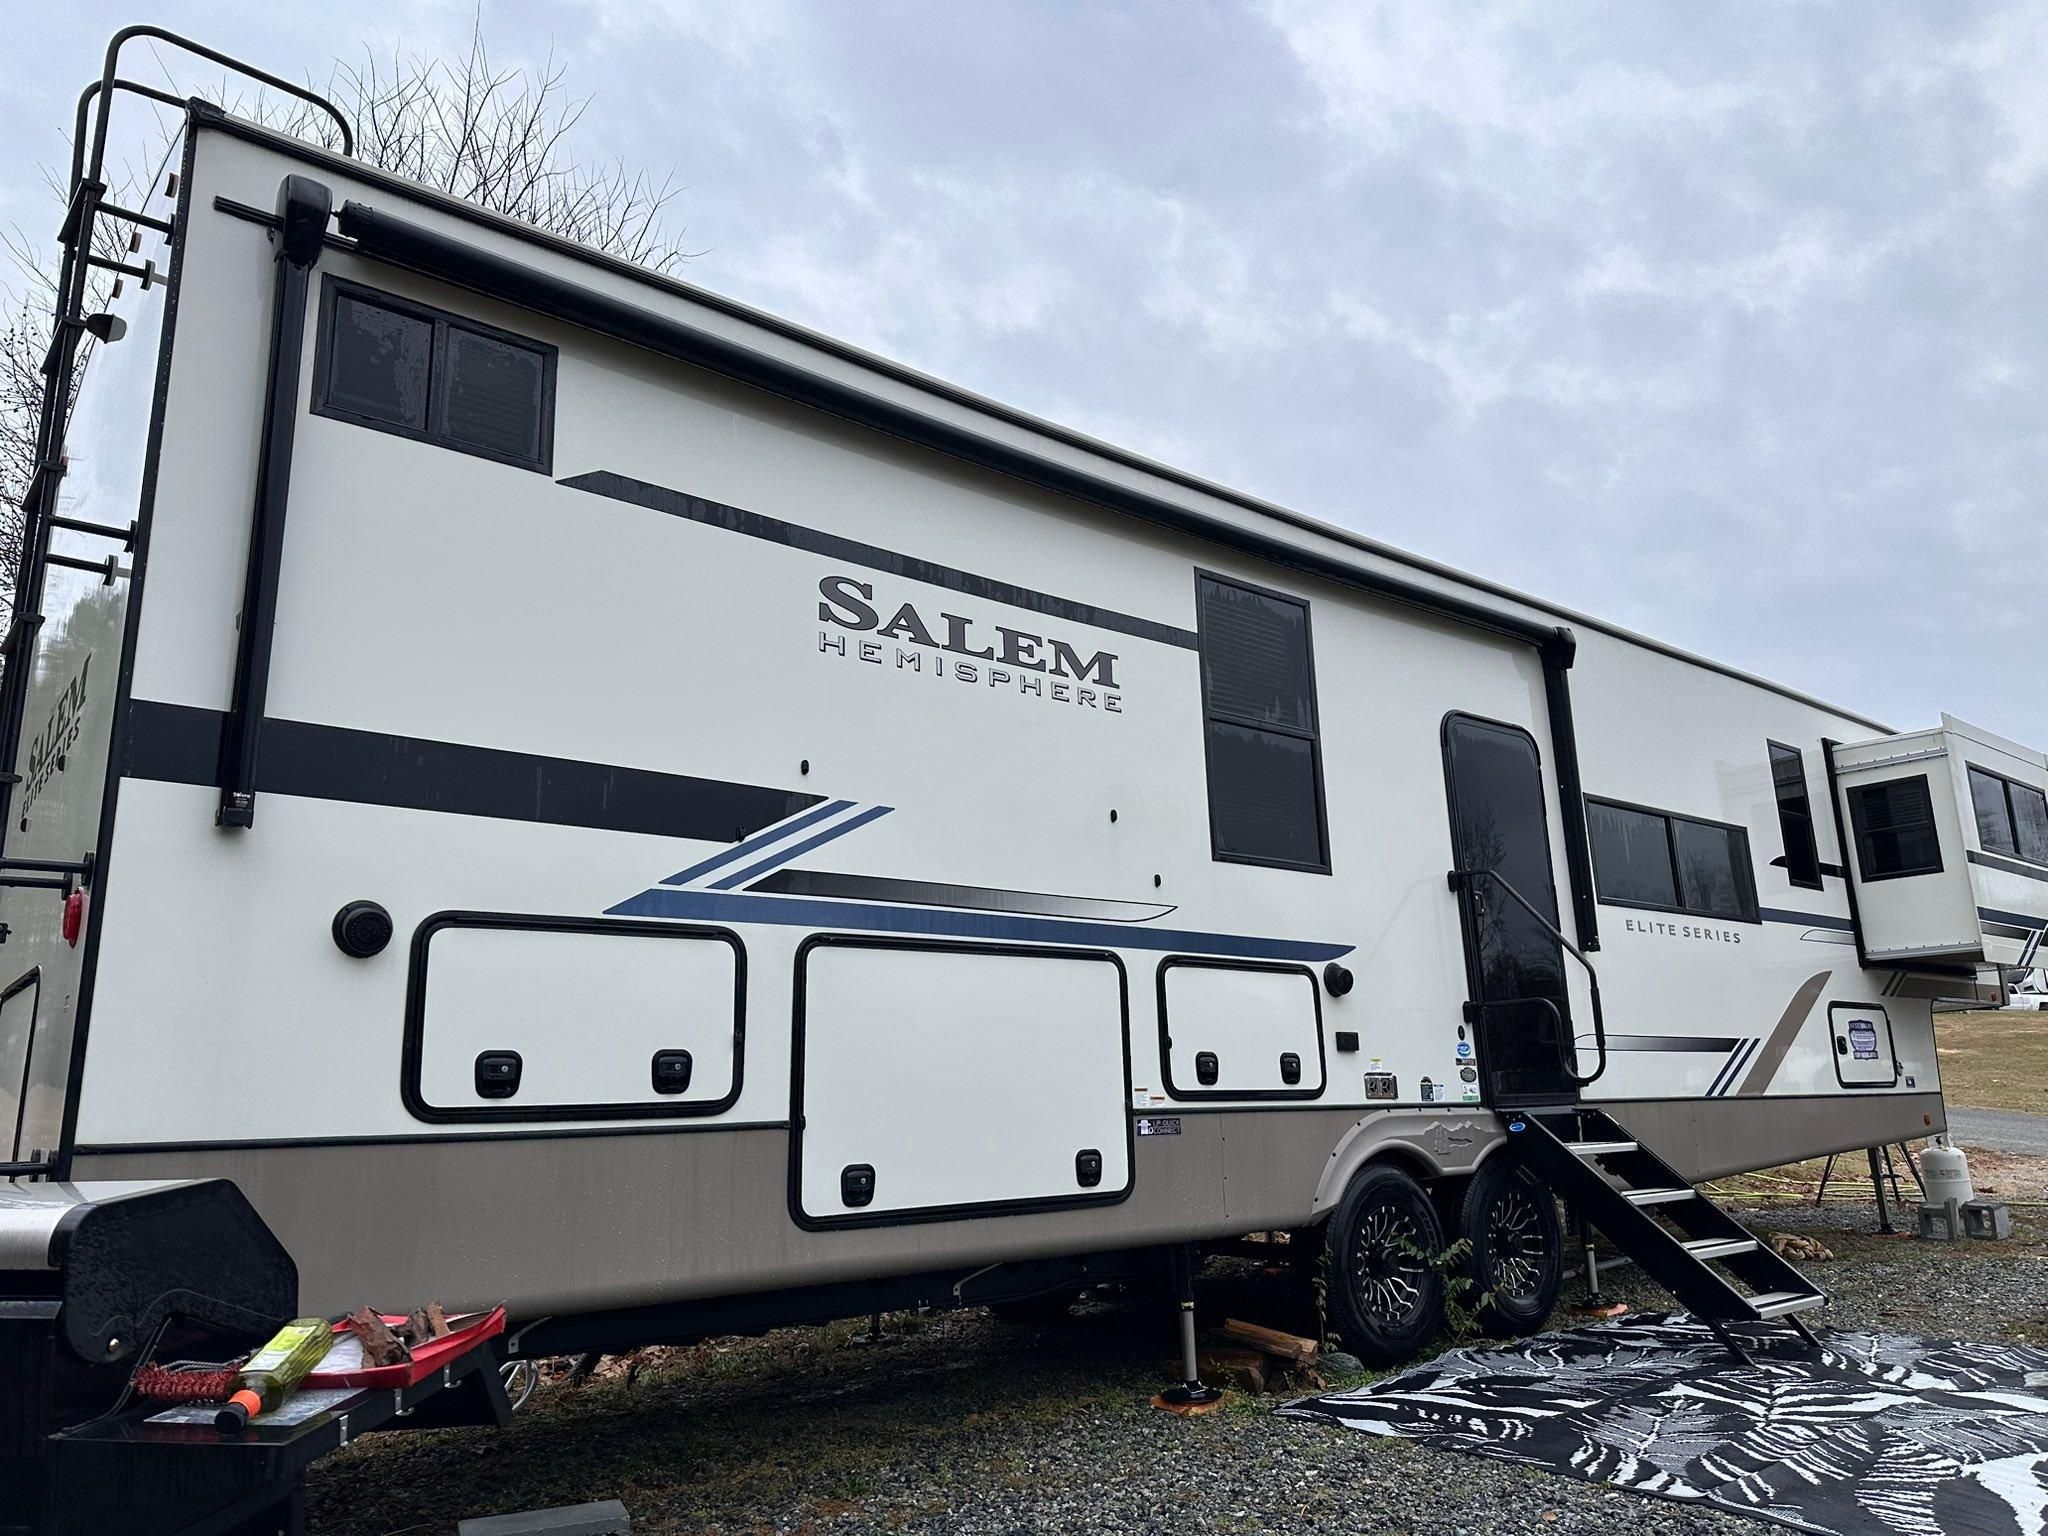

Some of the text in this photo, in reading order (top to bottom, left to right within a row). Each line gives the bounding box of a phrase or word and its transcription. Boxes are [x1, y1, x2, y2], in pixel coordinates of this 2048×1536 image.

[818, 576, 1120, 690] SALEM
[818, 631, 1122, 714] HEMISPHERE
[25, 652, 92, 793] SALEM
[1625, 919, 1741, 944] ELITE SERIES
[1153, 1127, 1180, 1135] CONNECT
